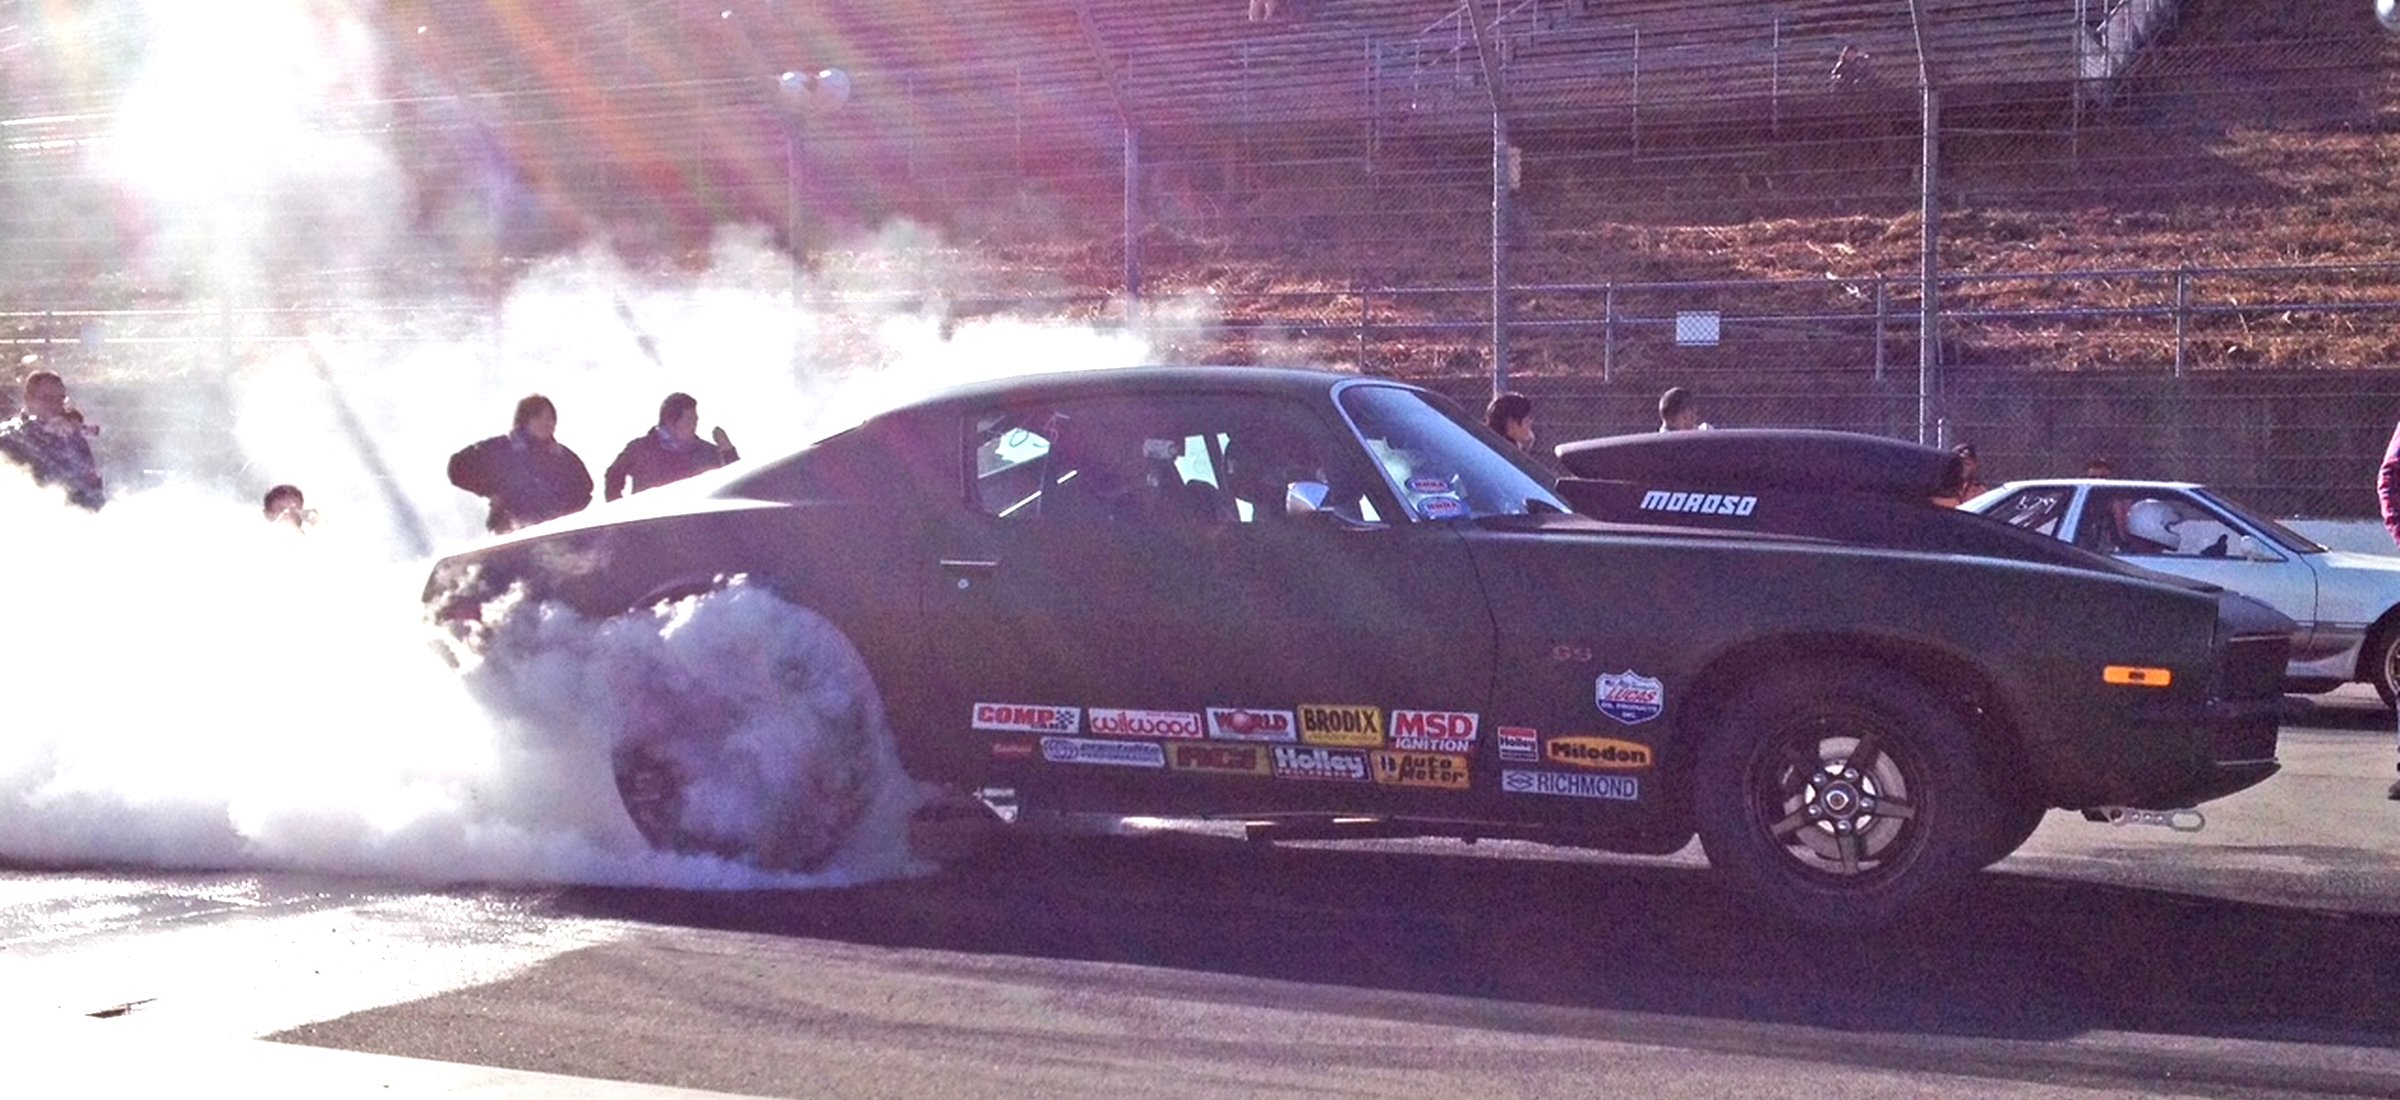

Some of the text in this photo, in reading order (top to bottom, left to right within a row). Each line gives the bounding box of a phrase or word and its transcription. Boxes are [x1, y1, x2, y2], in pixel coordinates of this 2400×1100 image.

[1641, 489, 1758, 517] MOROSO
[1606, 687, 1657, 702] LUCAS
[978, 706, 1055, 725] COMP
[1092, 711, 1200, 736] wilwood
[1303, 708, 1378, 734] BRODIX
[1395, 712, 1474, 739] MSD
[1396, 737, 1470, 752] IGNITION
[1550, 742, 1647, 764] Milodon
[1274, 747, 1365, 779] Holley
[1400, 755, 1453, 769] Auto
[1398, 766, 1465, 784] Meter
[1537, 775, 1636, 798] RICHMOND
